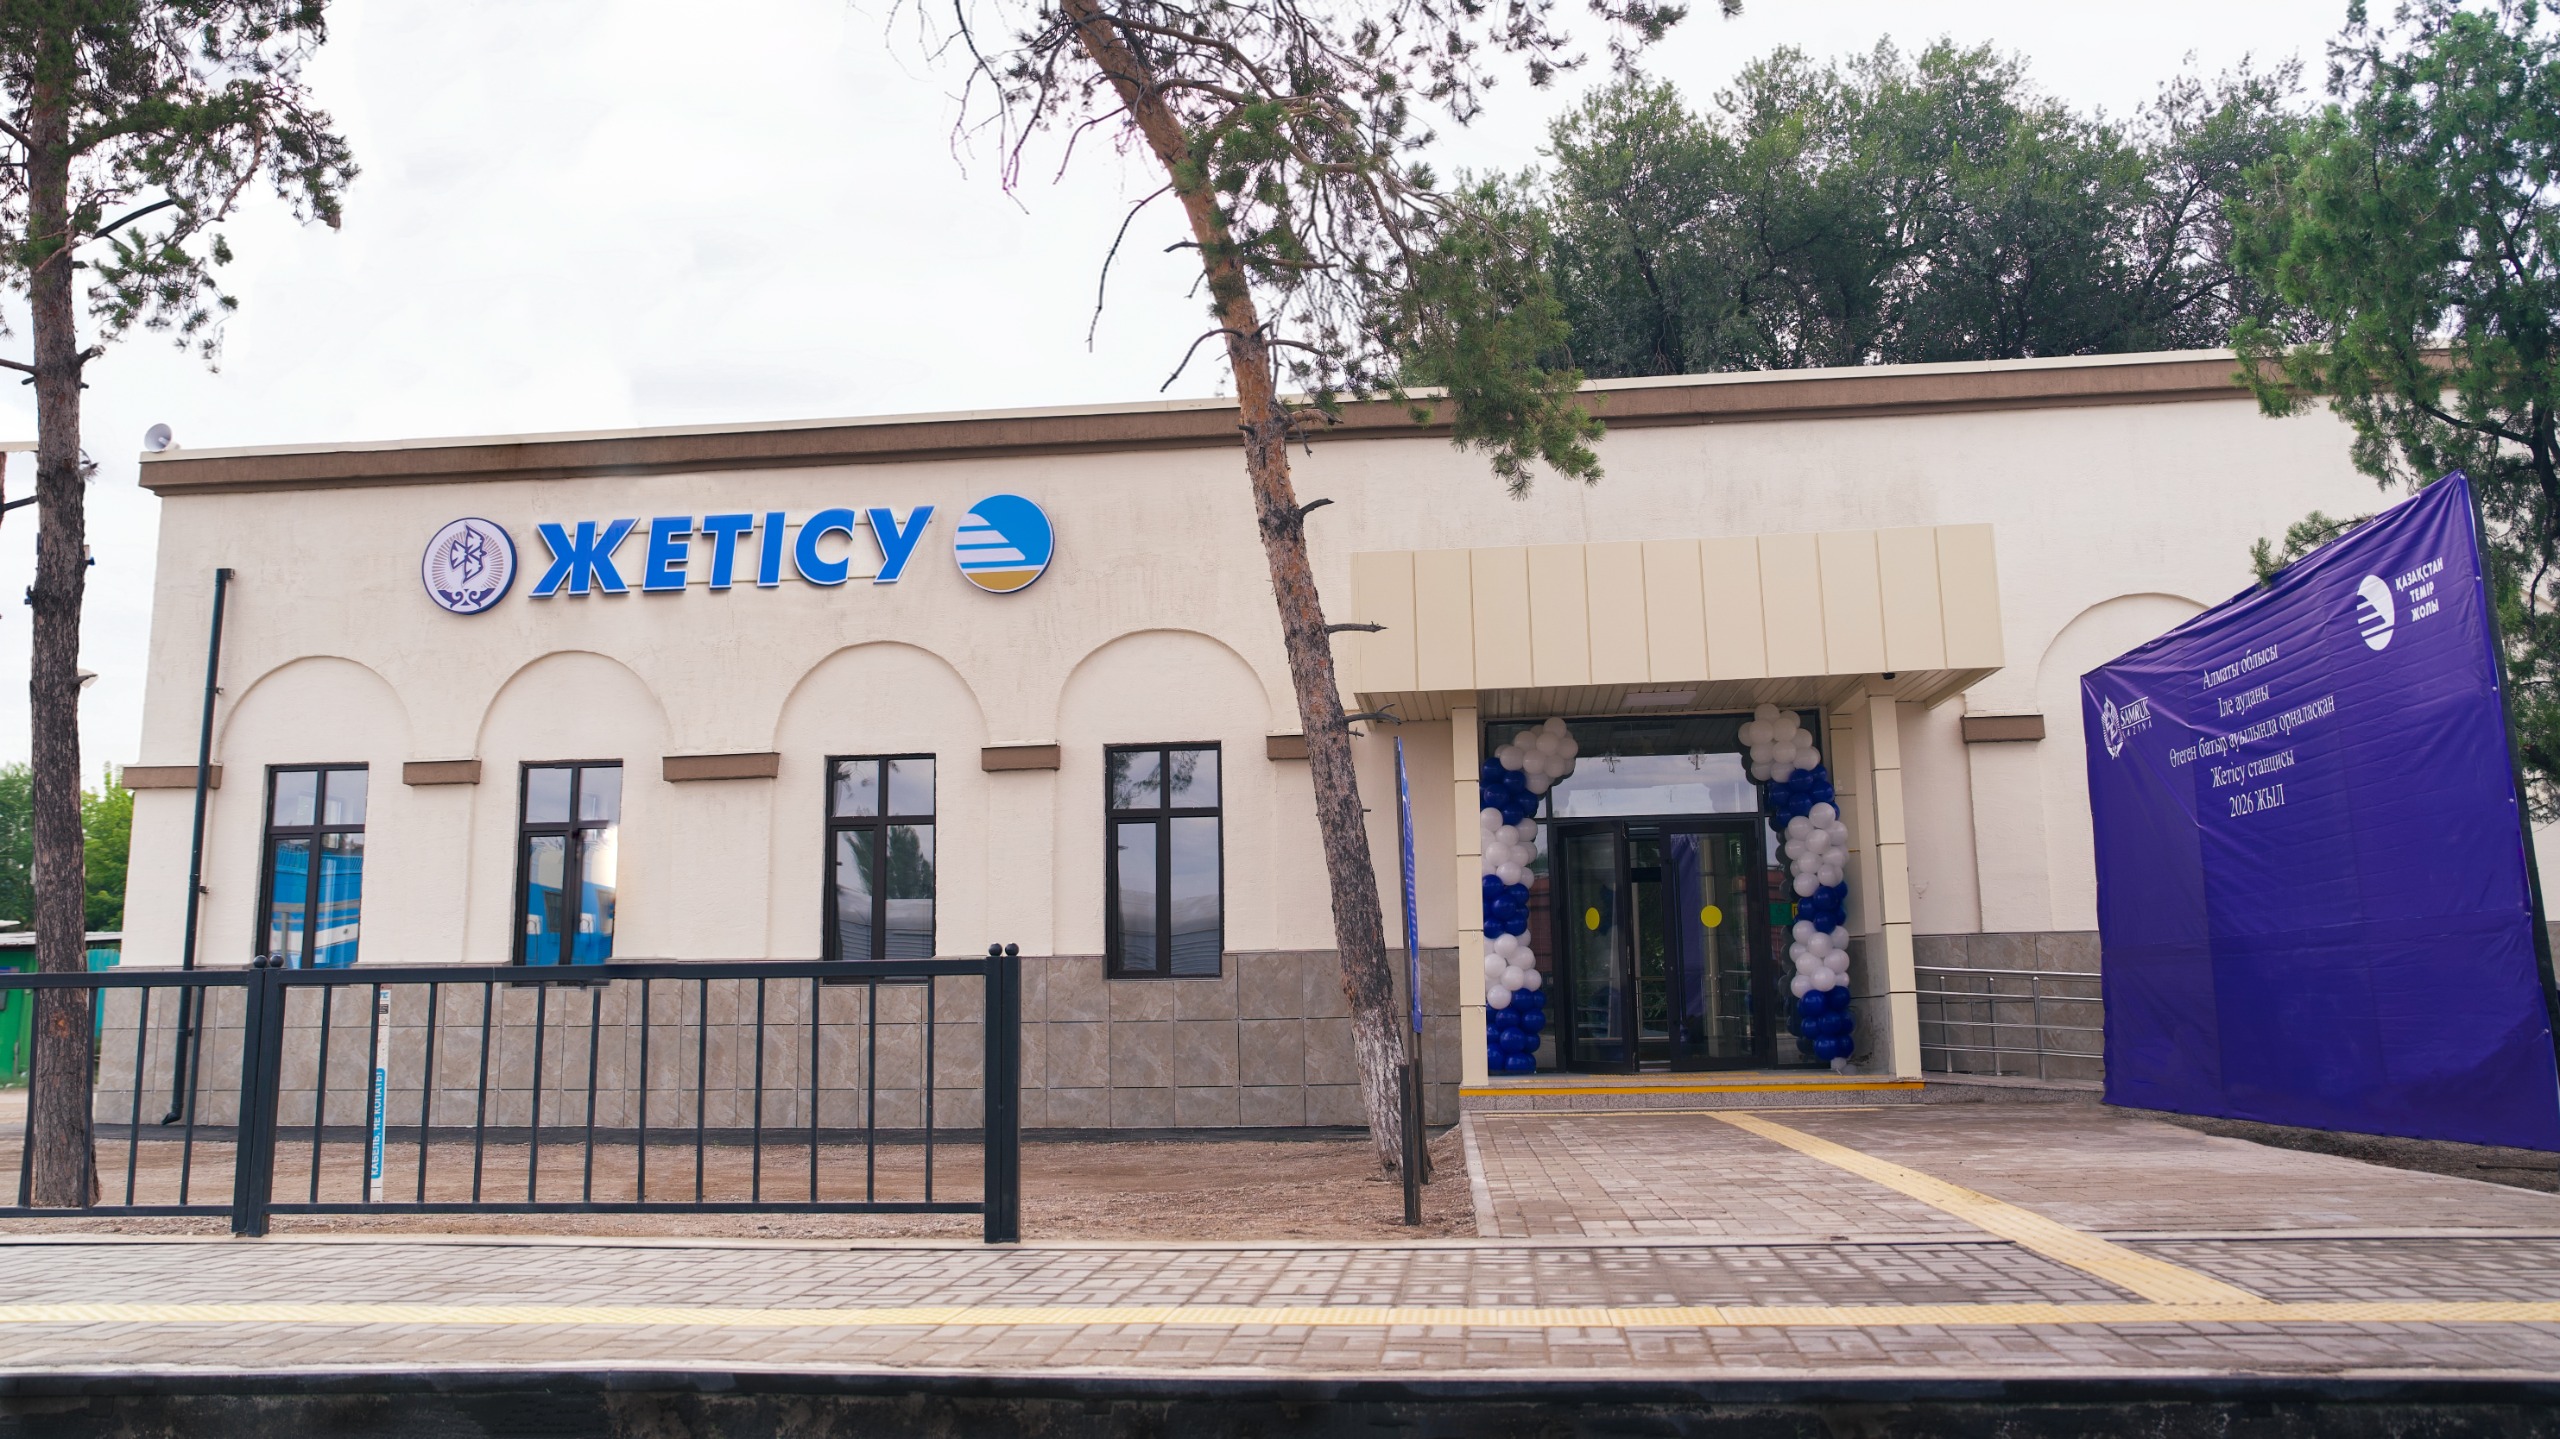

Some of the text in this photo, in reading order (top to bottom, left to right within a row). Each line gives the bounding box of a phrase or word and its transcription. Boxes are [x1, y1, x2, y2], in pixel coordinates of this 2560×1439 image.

[528, 505, 935, 600] ЖЕТІСУ
[2395, 557, 2444, 592] ҚАЗАҚСТАН
[2409, 581, 2435, 603] ТЕМІР
[2411, 598, 2440, 622] ЖОЛЫ
[2203, 644, 2278, 690] Алматы облысы
[2120, 699, 2151, 727] SAMRUK
[2217, 684, 2270, 717] Іле ауданы
[2169, 695, 2336, 768] Өтеген батыр ауылында орналасқан
[2210, 761, 2246, 788] Жетісу
[2228, 783, 2286, 818] 2026 ЖЫЛ
